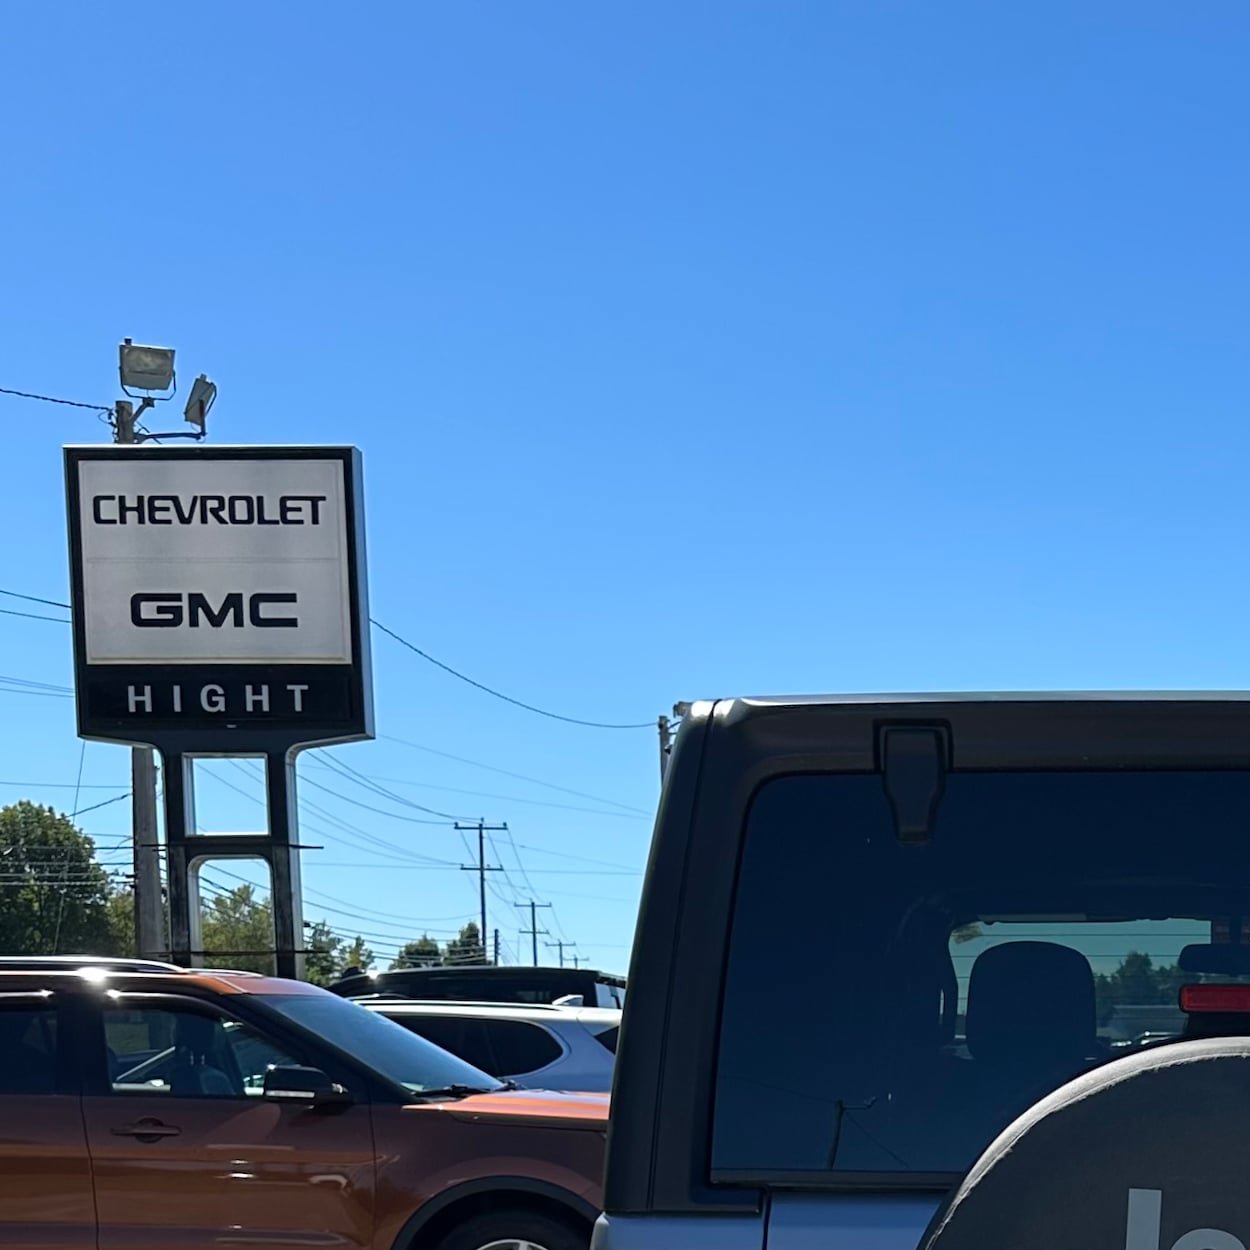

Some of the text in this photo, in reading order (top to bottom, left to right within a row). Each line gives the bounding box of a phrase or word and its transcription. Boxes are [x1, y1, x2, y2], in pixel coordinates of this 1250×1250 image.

[93, 495, 326, 525] CHEVROLET
[130, 593, 298, 628] GMC
[127, 684, 309, 712] HIGHT
